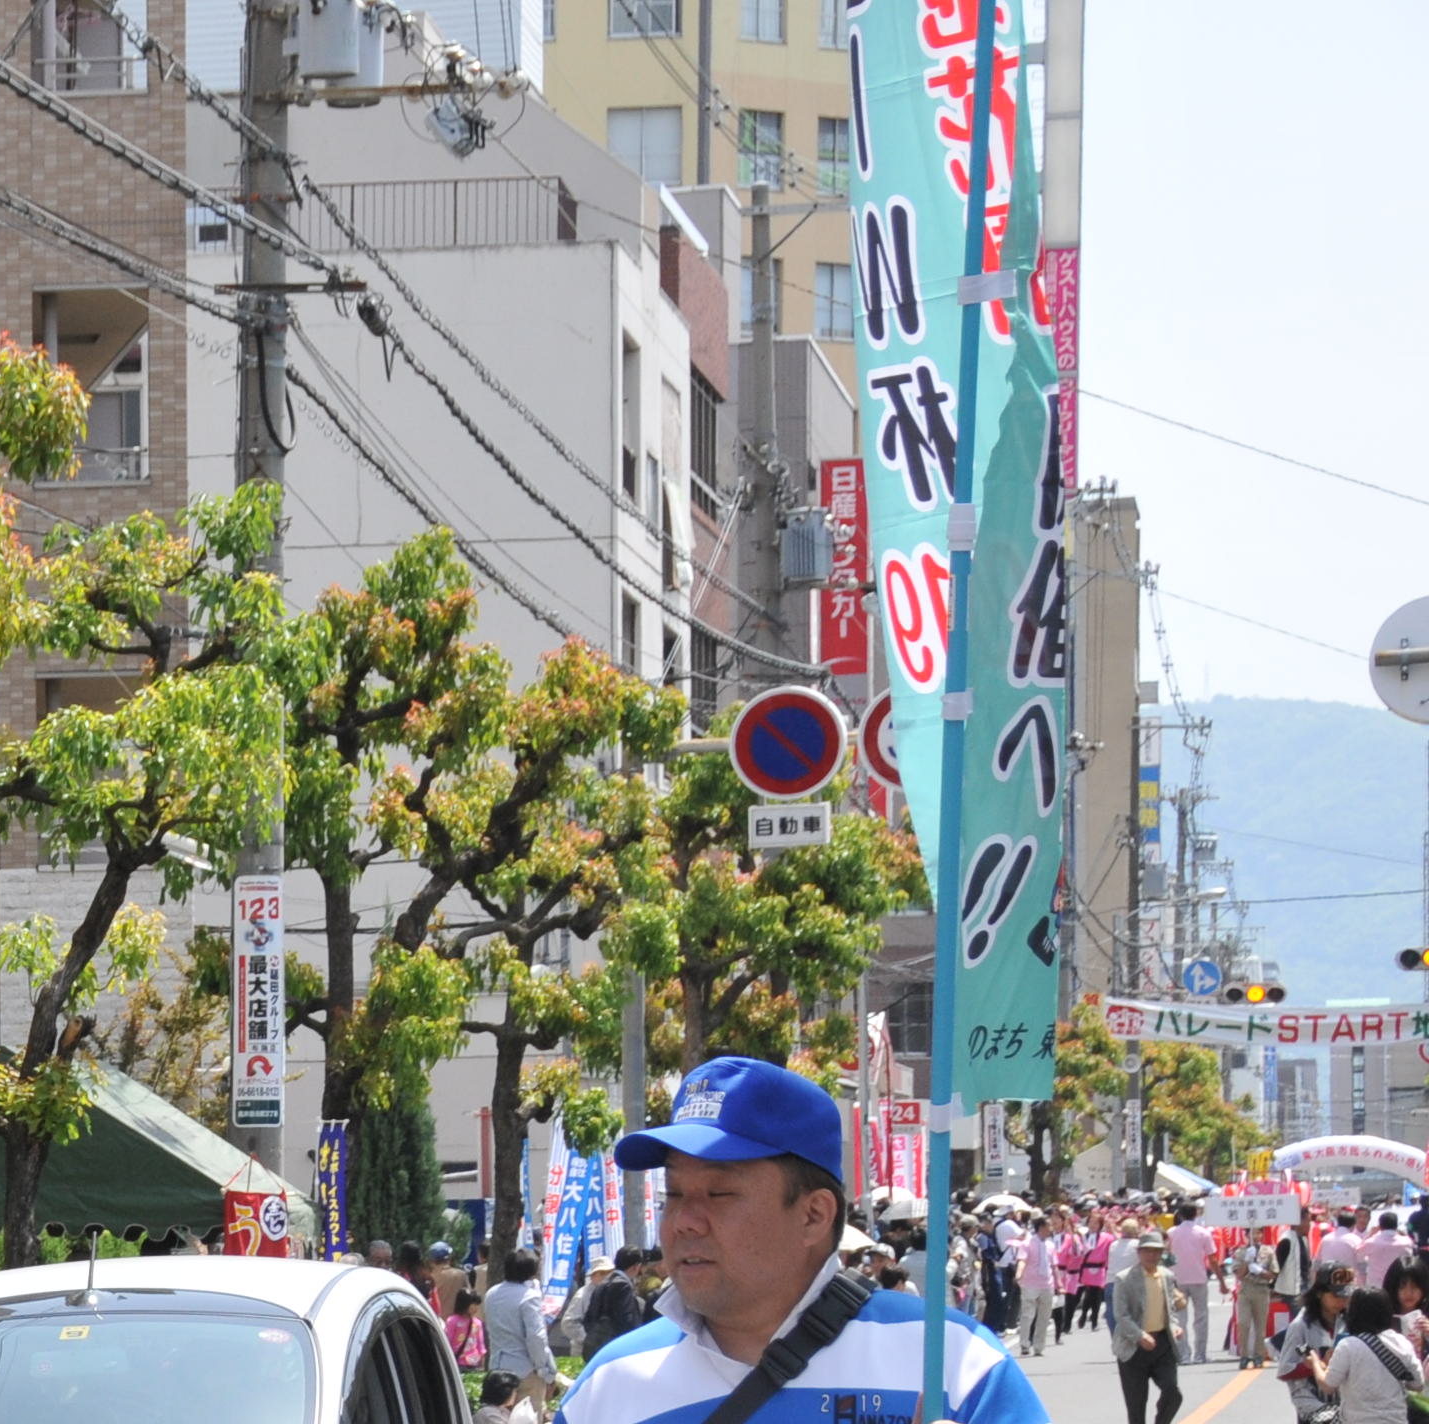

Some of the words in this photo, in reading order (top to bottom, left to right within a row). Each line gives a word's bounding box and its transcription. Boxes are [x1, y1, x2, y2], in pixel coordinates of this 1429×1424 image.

[756, 816, 821, 836] 自動車
[238, 896, 279, 920] 123
